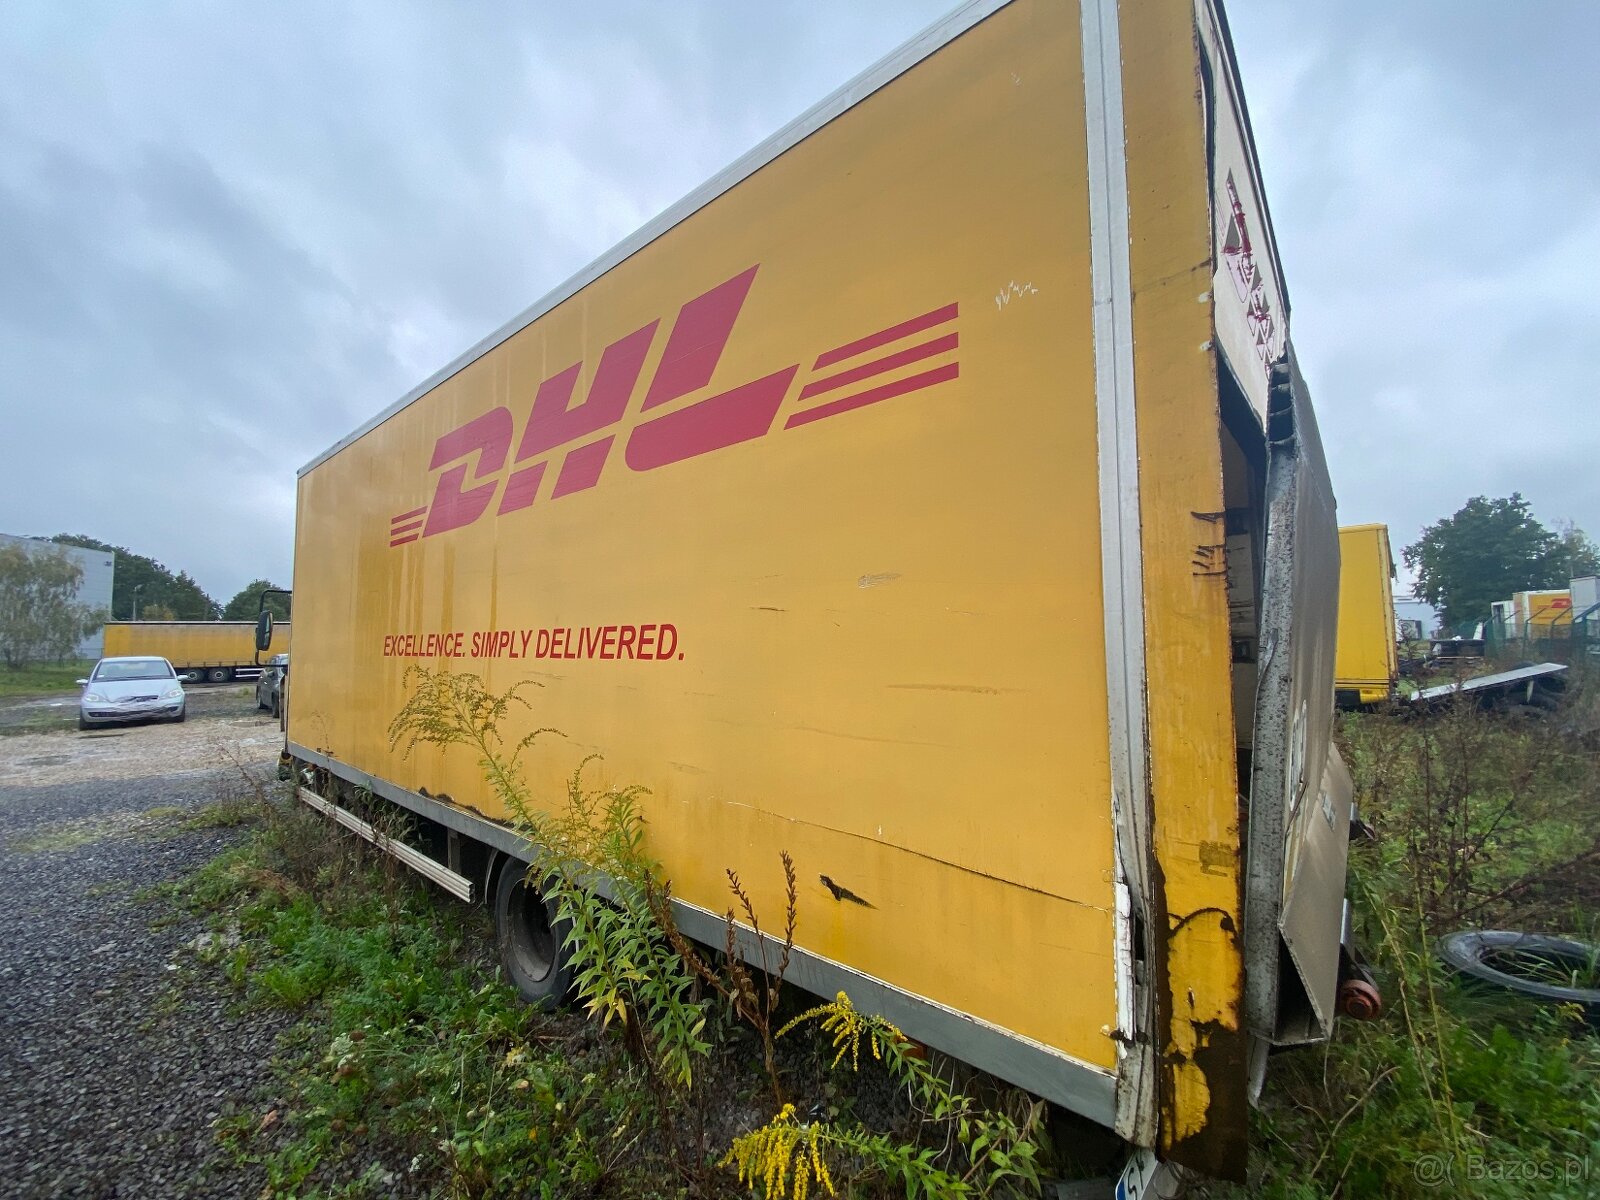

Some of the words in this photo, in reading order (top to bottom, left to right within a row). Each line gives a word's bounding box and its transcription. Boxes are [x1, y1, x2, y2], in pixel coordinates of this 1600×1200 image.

[421, 263, 799, 539] DHL
[383, 632, 465, 657] EXCELLENCE.
[470, 629, 533, 659] SIMPLY
[535, 623, 685, 661] DELIVERED.
